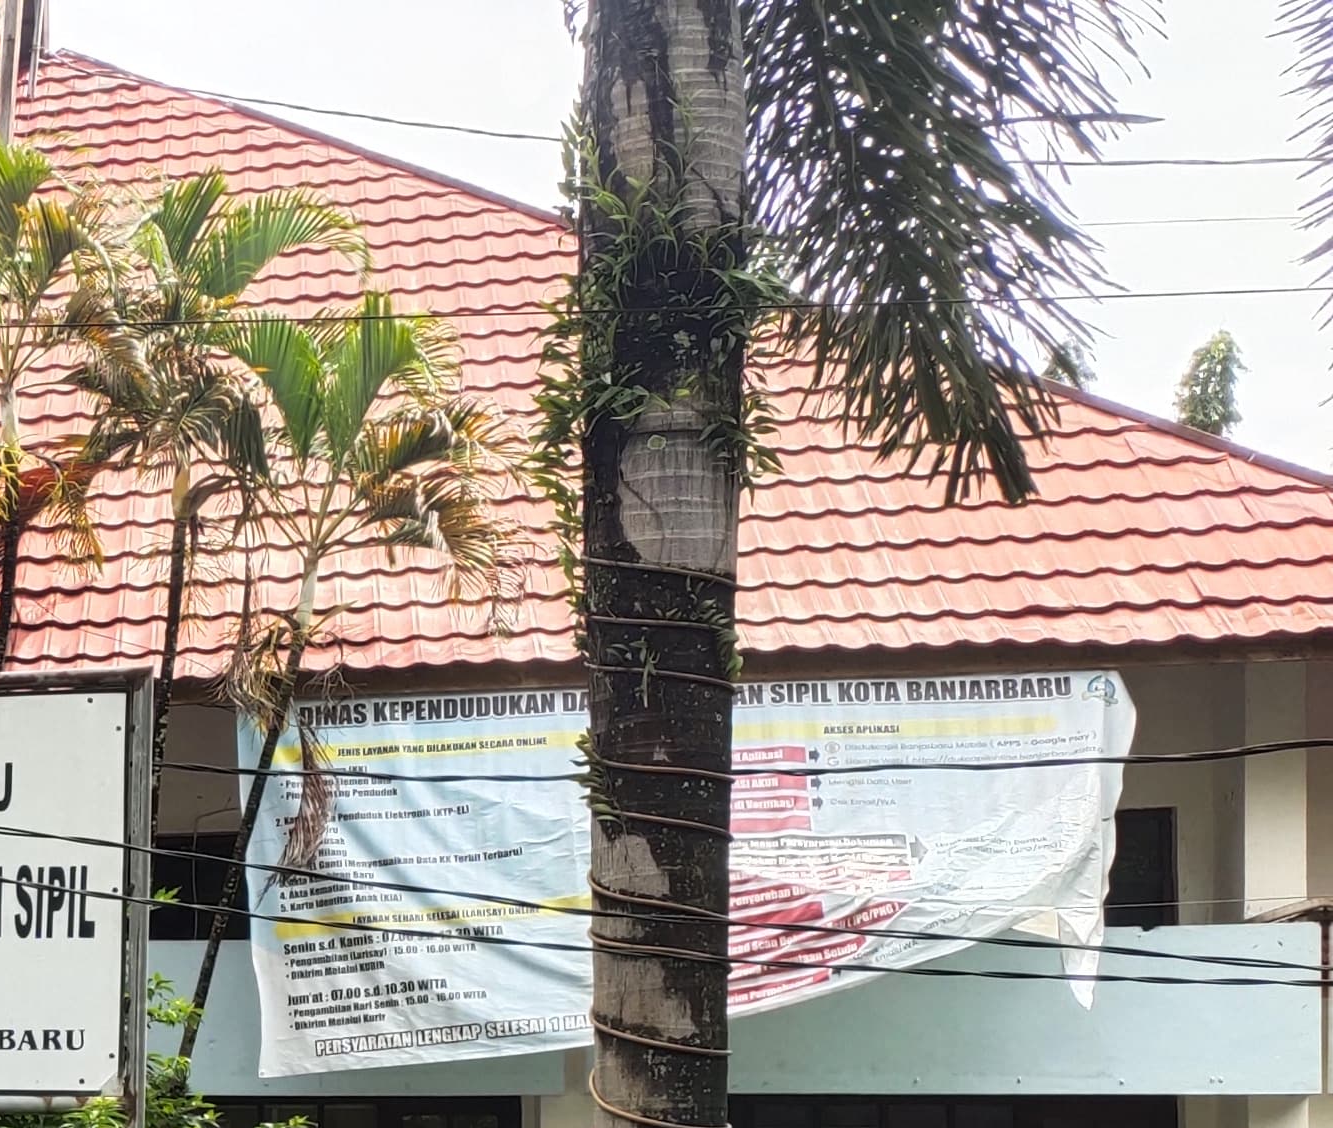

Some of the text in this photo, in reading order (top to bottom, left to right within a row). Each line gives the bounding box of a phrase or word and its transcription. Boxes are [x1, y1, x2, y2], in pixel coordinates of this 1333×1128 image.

[300, 703, 367, 726] DINAS
[374, 692, 556, 722] KEPENDUDUKAN
[770, 682, 832, 704] SIPIL
[838, 681, 901, 703] KOTA
[906, 676, 1072, 702] BANJARBARU
[823, 724, 900, 735] AKSES APLIKASI
[337, 736, 548, 757] JENIS LAYANAN YANG DILAKUKAN SECARA ONLINE
[14, 864, 95, 940] SIPIL
[426, 910, 460, 922] SELESAI
[283, 942, 317, 956] Senin
[339, 933, 374, 949] Kamis
[290, 954, 349, 968] Pengambilan
[331, 987, 361, 1001] 07.00
[385, 981, 415, 995] 10.30
[416, 978, 448, 990] WITA
[293, 1003, 352, 1018] Pengambilan
[405, 995, 429, 1007] 15.00
[462, 990, 487, 1000] WITA
[315, 1031, 412, 1057] PERSYARATAN
[415, 1022, 482, 1047] LENGKAP
[484, 1017, 545, 1039] SELESAI
[549, 1016, 559, 1032] 1
